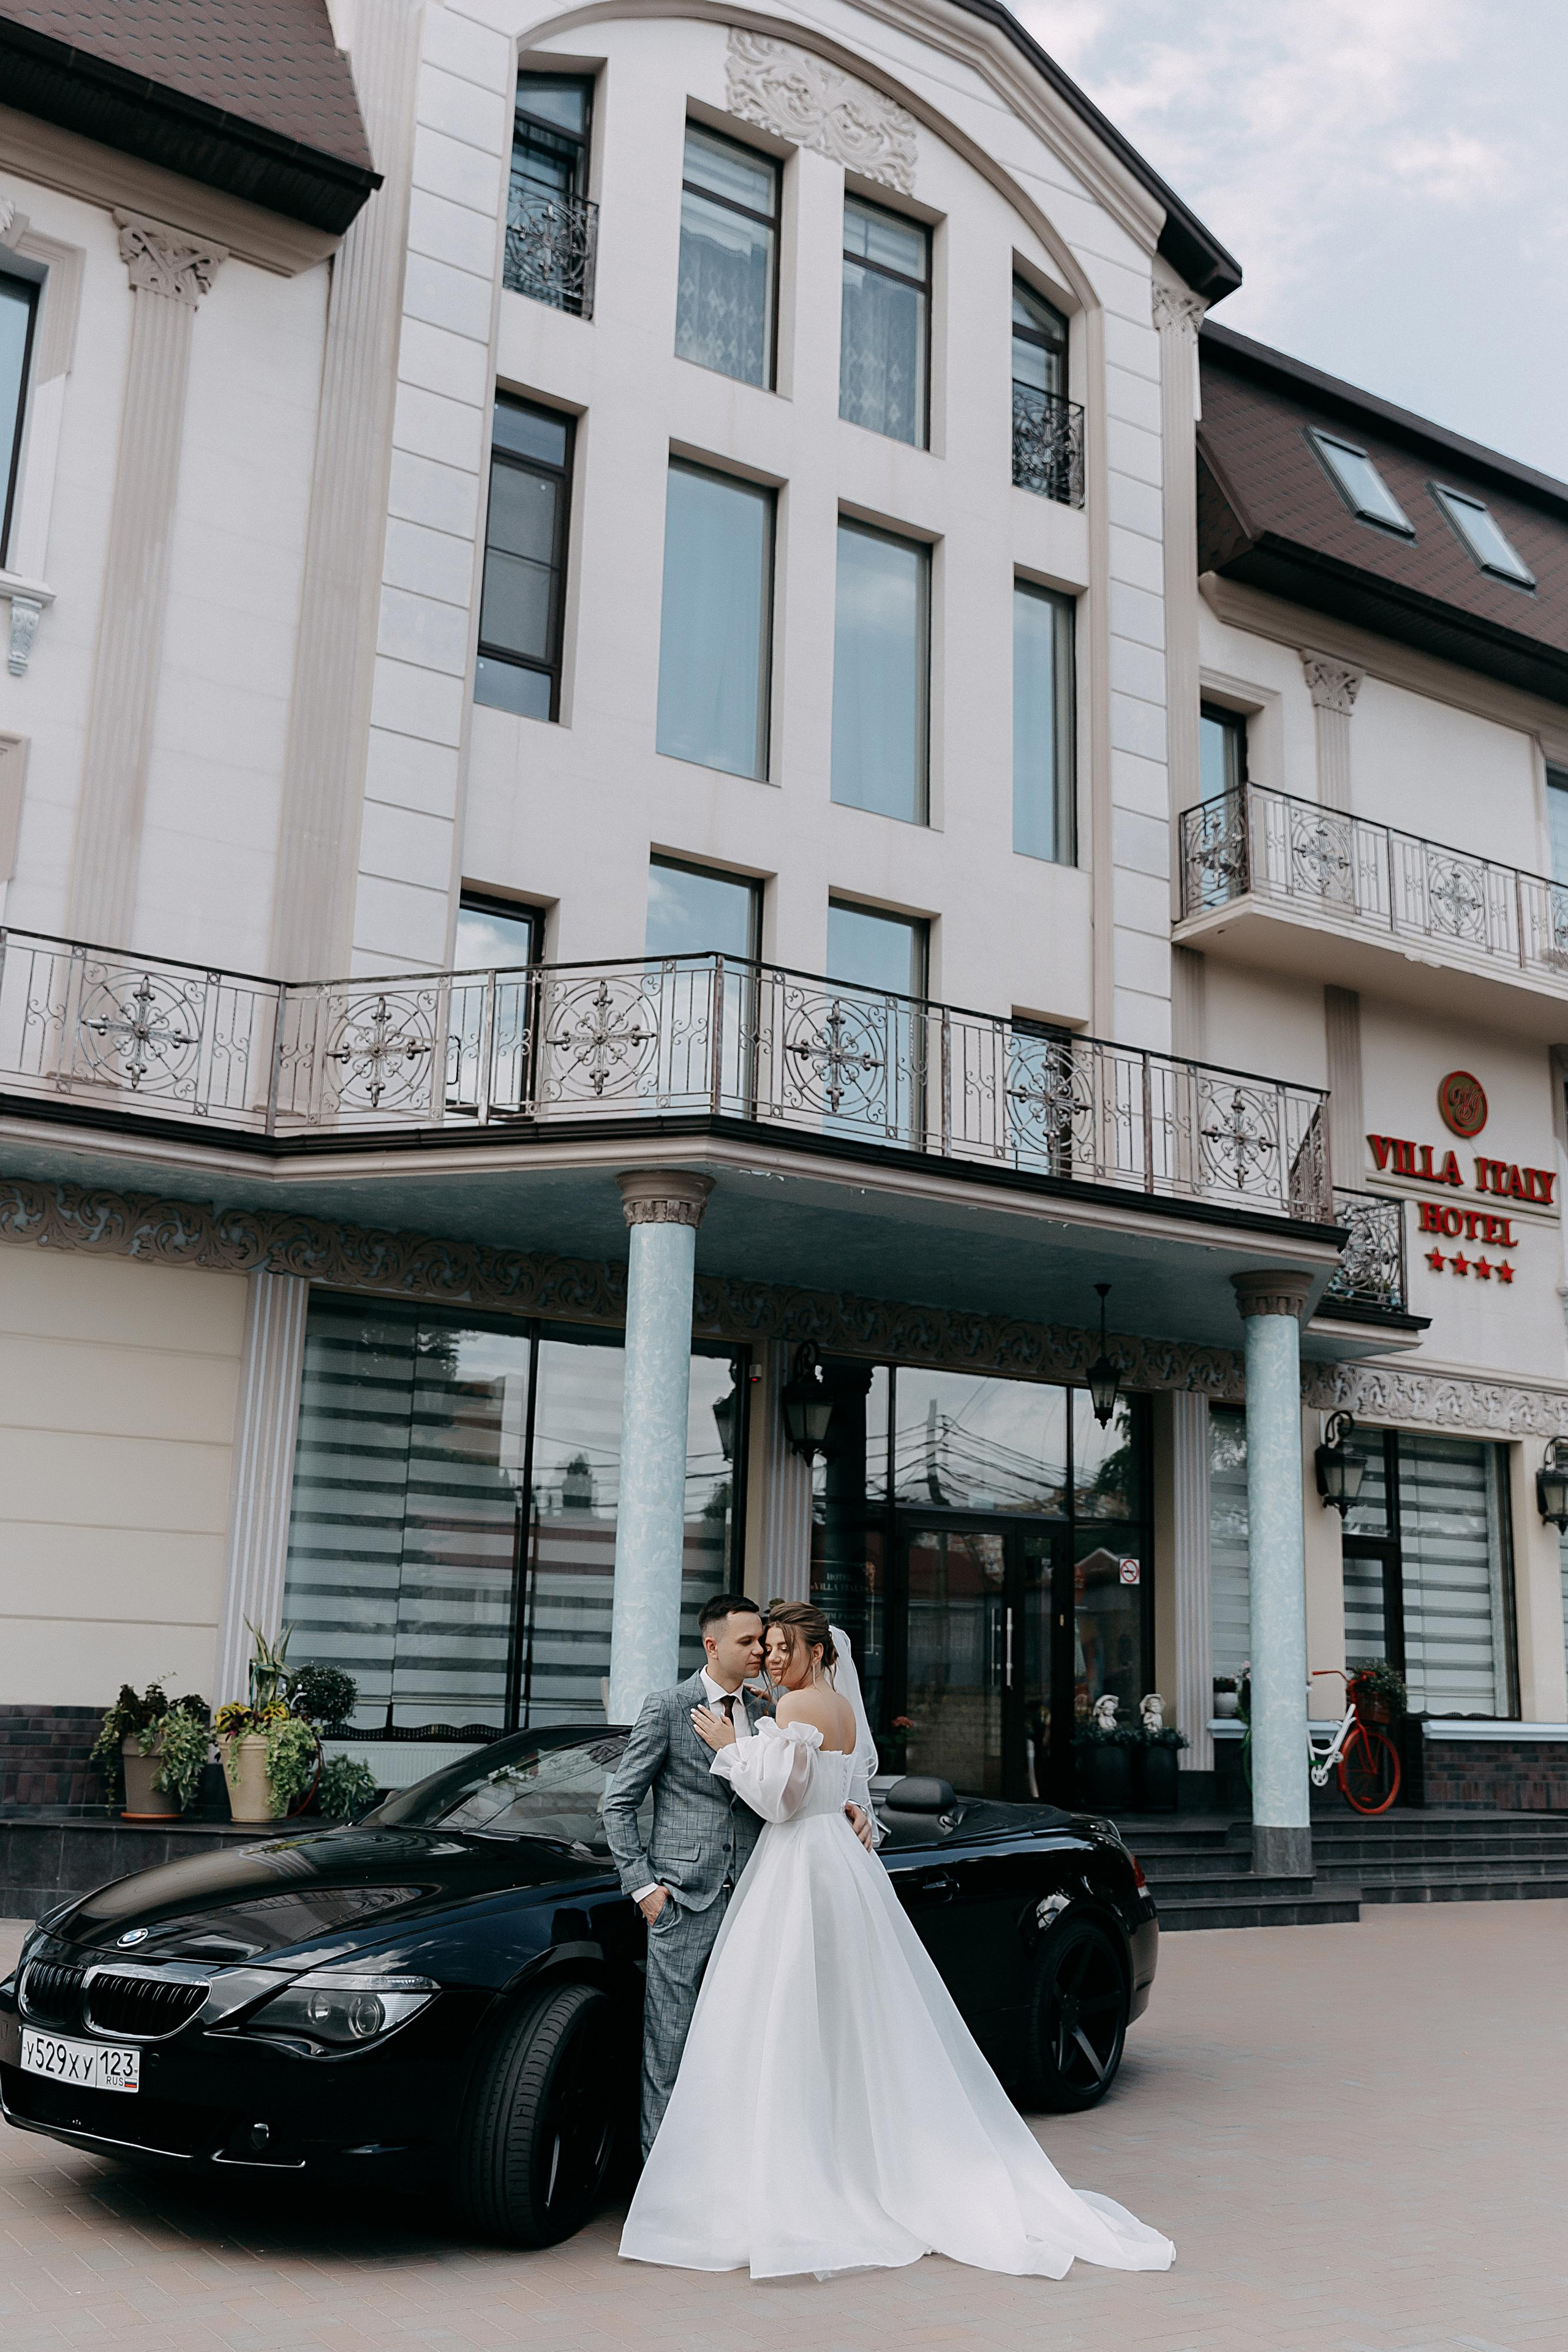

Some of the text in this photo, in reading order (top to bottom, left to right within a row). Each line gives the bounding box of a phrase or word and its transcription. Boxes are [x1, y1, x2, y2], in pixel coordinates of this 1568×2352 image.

[1366, 1134, 1556, 1205] VILLA ITALY
[1419, 1202, 1518, 1246] HOTEL
[100, 2050, 133, 2076] 123
[106, 2076, 124, 2086] RUS
